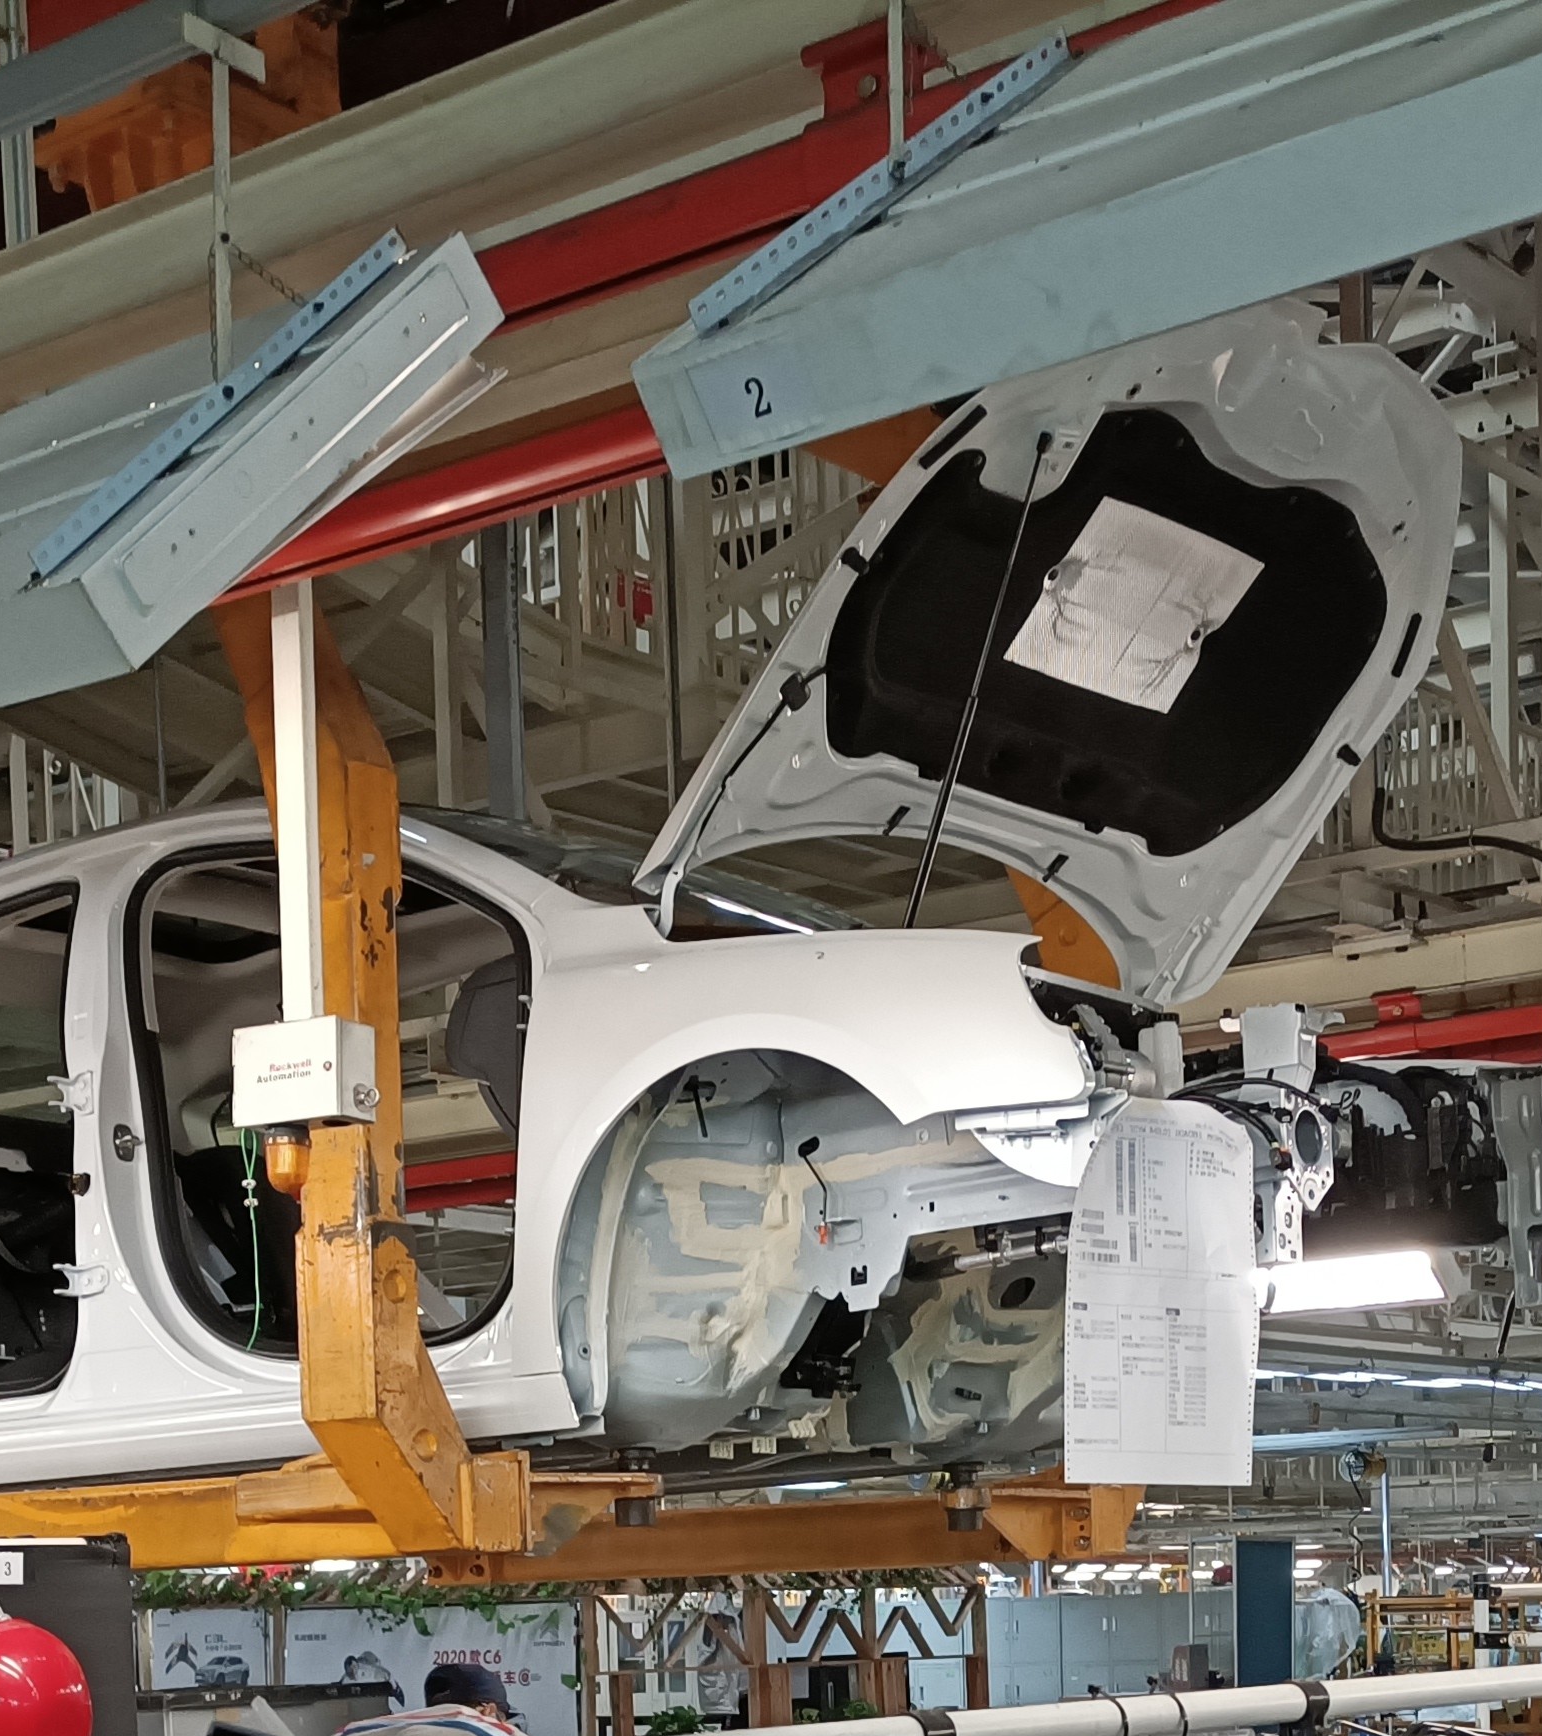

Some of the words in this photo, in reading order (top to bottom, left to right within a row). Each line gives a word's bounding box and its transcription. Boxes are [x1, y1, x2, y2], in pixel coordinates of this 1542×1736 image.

[744, 377, 772, 419] 2
[269, 1059, 312, 1072] Rockwell
[256, 1070, 311, 1083] Automation
